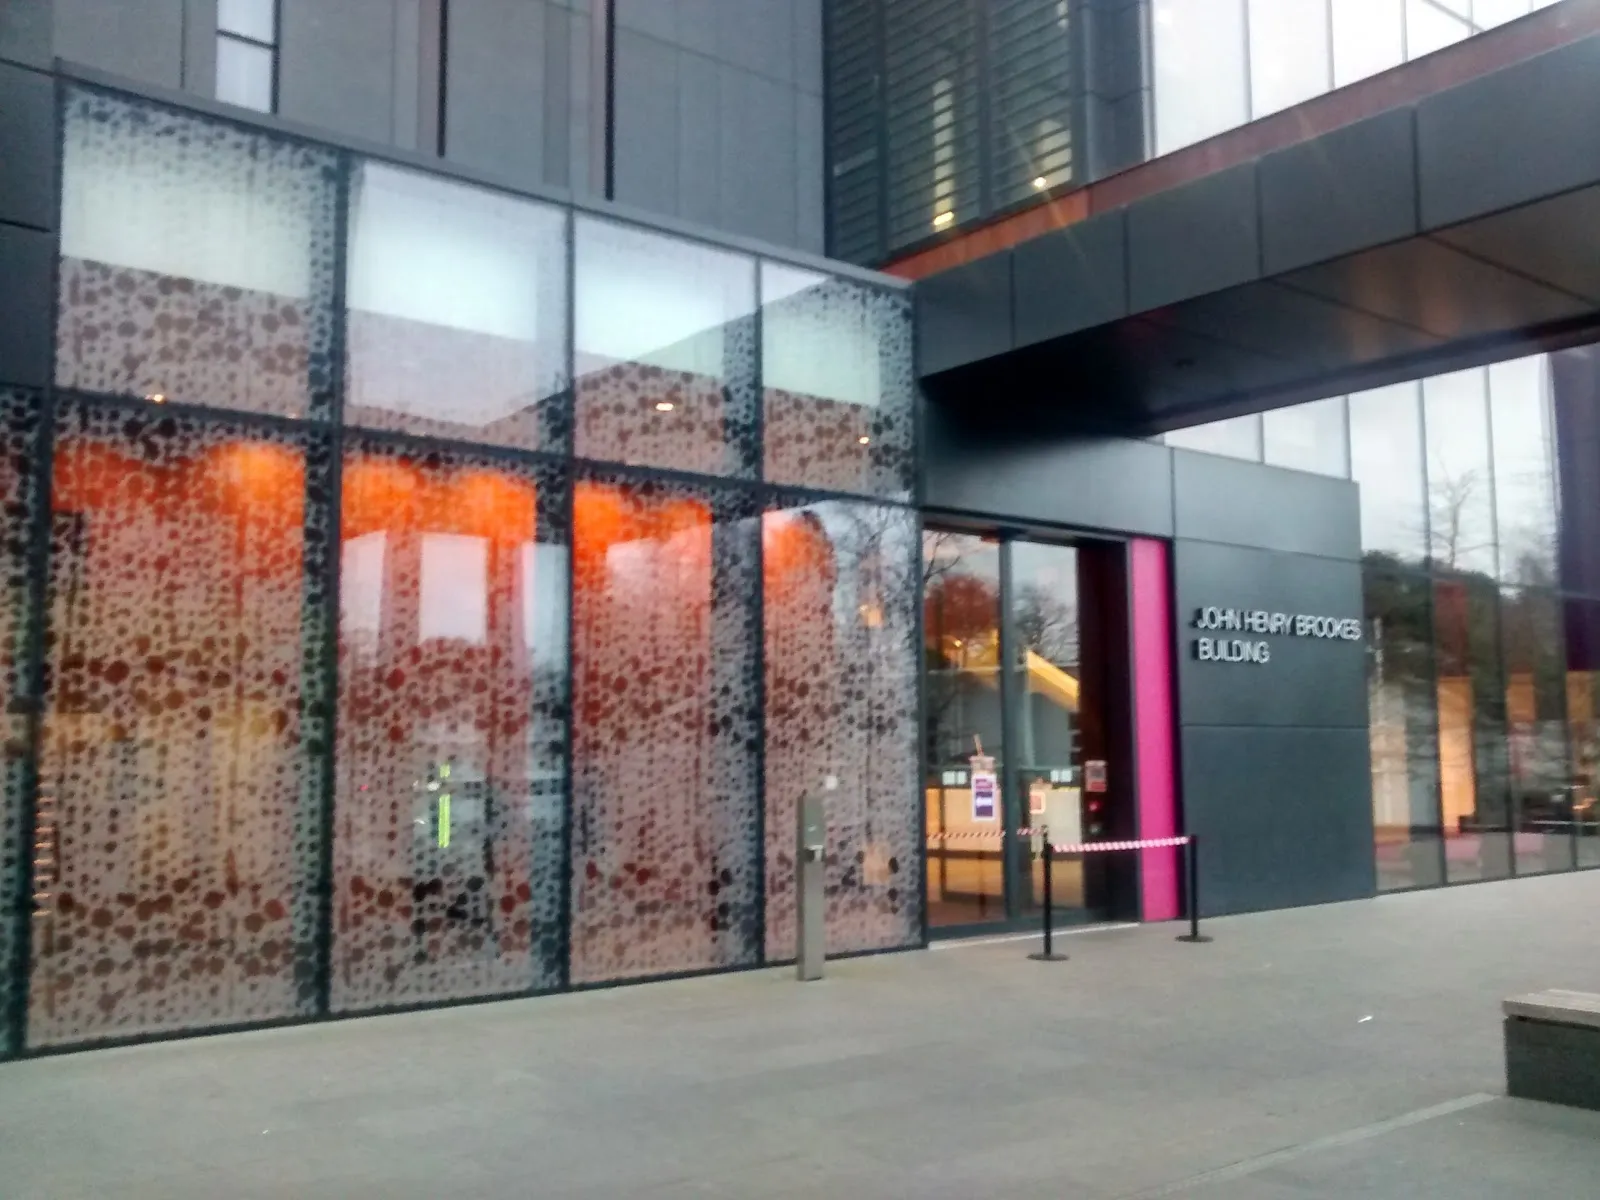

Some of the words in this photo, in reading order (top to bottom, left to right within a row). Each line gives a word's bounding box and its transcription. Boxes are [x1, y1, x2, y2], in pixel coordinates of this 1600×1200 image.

[1197, 606, 1241, 630] JOHN
[1244, 610, 1295, 635] HENRY
[1295, 614, 1362, 640] BROOKES
[1199, 637, 1271, 664] BUILDING
